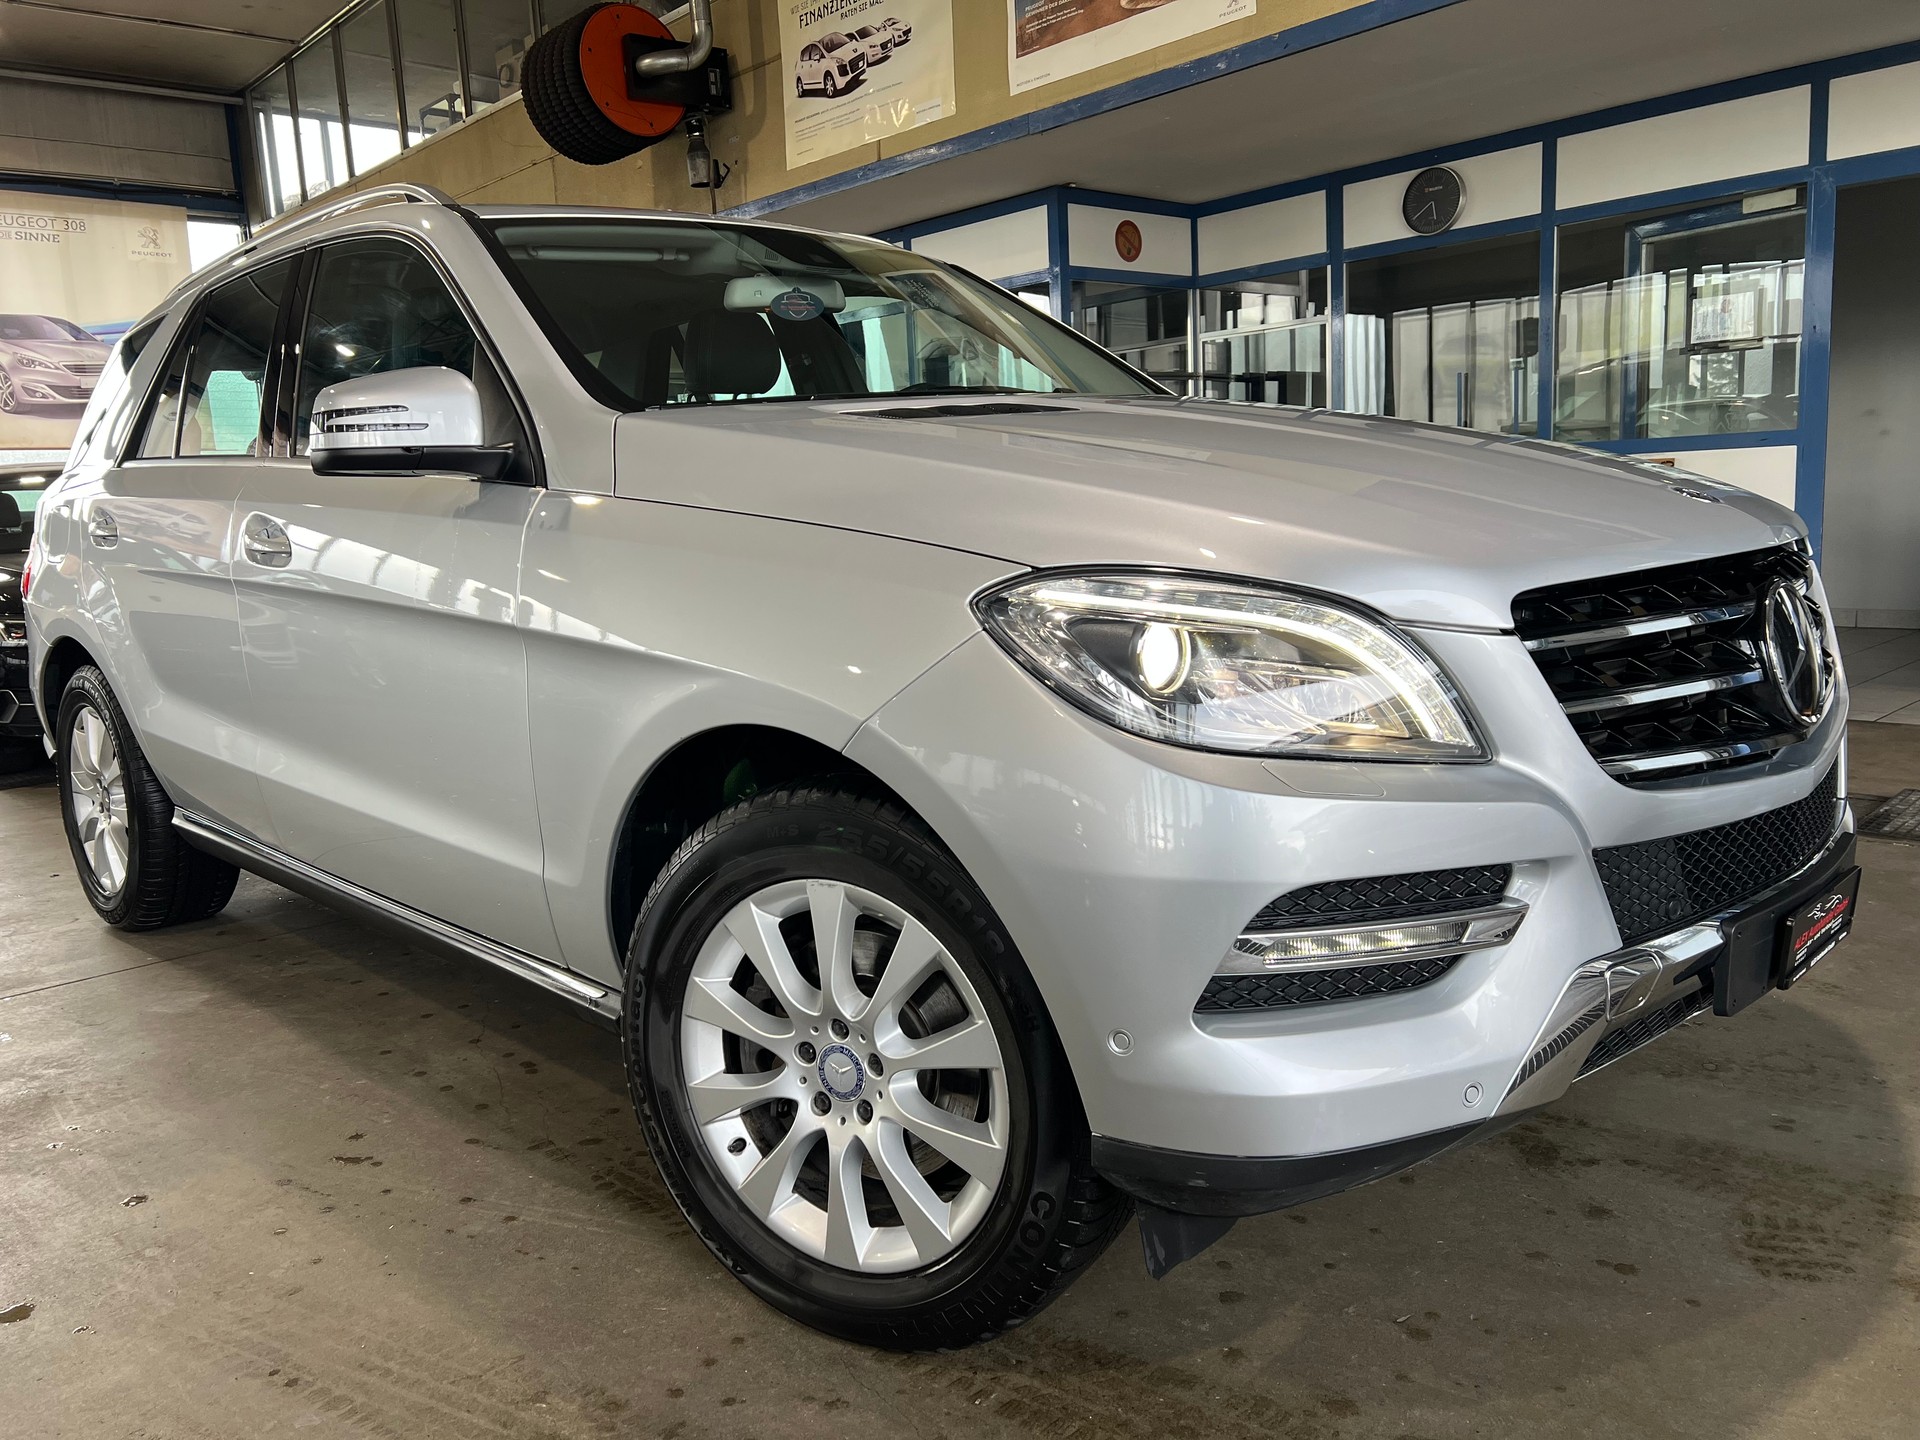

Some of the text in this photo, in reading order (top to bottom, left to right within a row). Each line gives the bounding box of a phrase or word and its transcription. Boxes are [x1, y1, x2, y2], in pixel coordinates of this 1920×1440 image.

[798, 0, 861, 29] FINANZIER
[840, 8, 858, 21] RATEN
[858, 2, 868, 12] SIE
[1218, 5, 1247, 18] PEUGEOT
[63, 219, 87, 232] 308
[14, 231, 61, 243] SINNE
[131, 250, 173, 258] PEUGEOT
[766, 823, 800, 839] M+S
